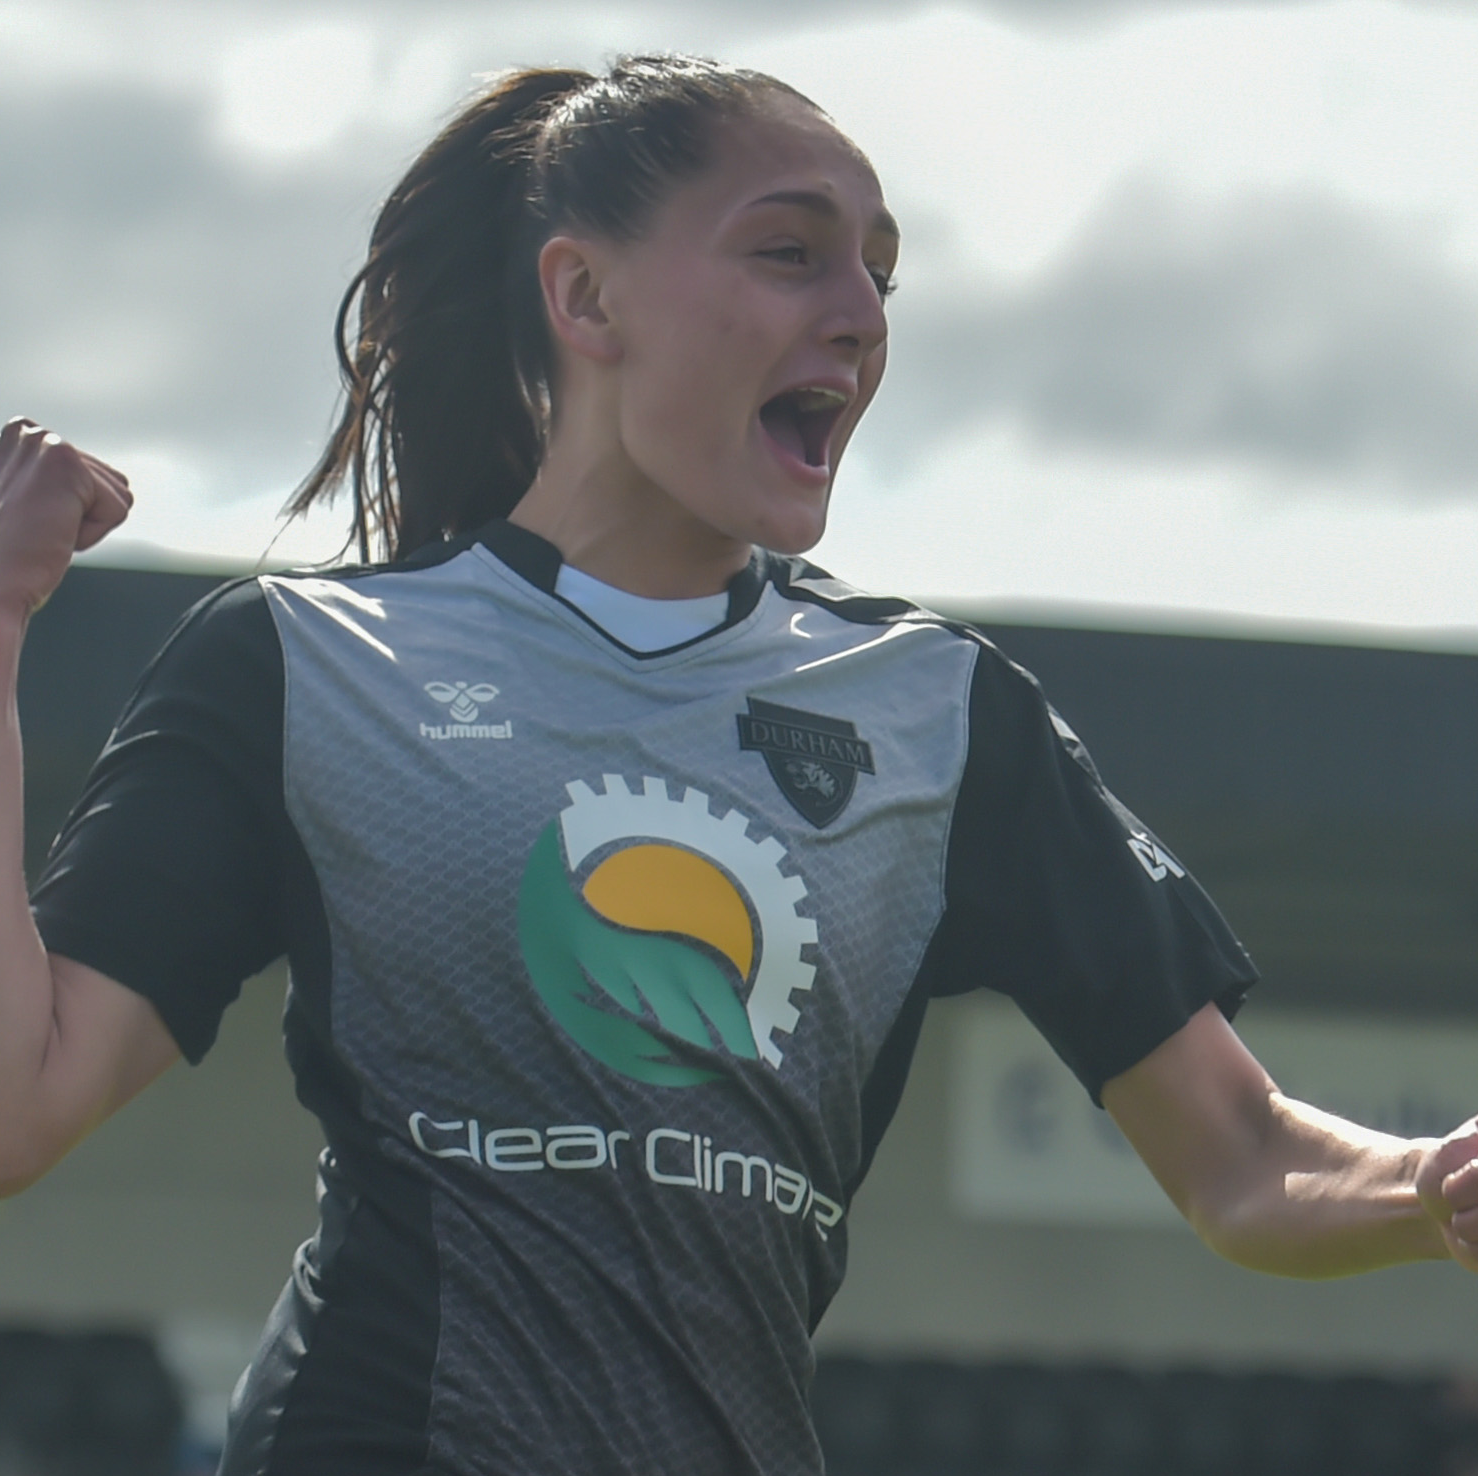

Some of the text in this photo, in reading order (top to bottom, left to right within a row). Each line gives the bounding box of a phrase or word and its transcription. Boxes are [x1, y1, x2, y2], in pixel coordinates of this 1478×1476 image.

[419, 719, 514, 740] hummel
[751, 721, 866, 765] DURHAM
[408, 1111, 630, 1171] Clear
